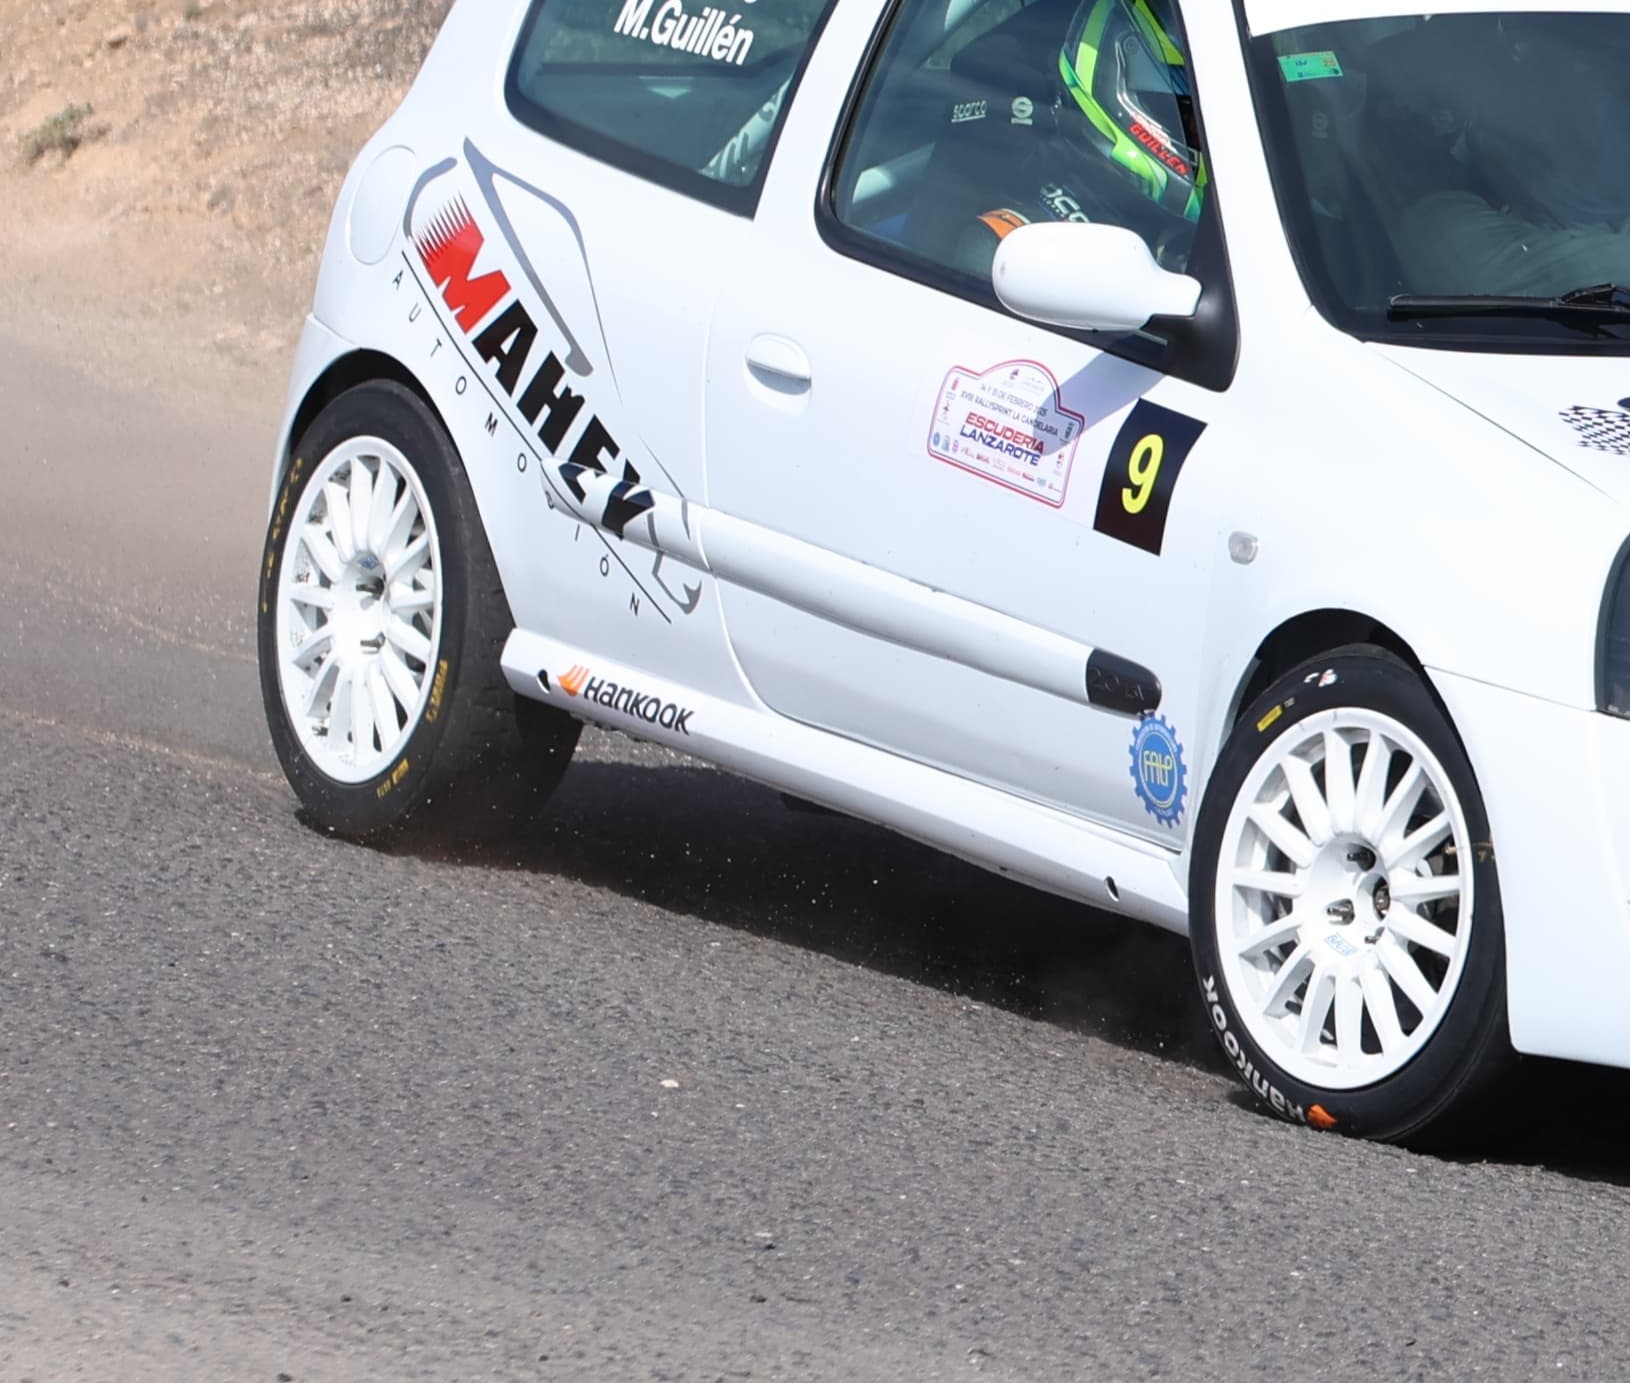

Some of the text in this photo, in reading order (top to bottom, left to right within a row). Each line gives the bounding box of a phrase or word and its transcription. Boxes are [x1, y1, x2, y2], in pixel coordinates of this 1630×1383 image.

[413, 194, 655, 539] MAHEY
[960, 425, 1041, 466] LANZAROTE
[965, 412, 1045, 454] ESCUDERIA
[1121, 433, 1164, 514] 9
